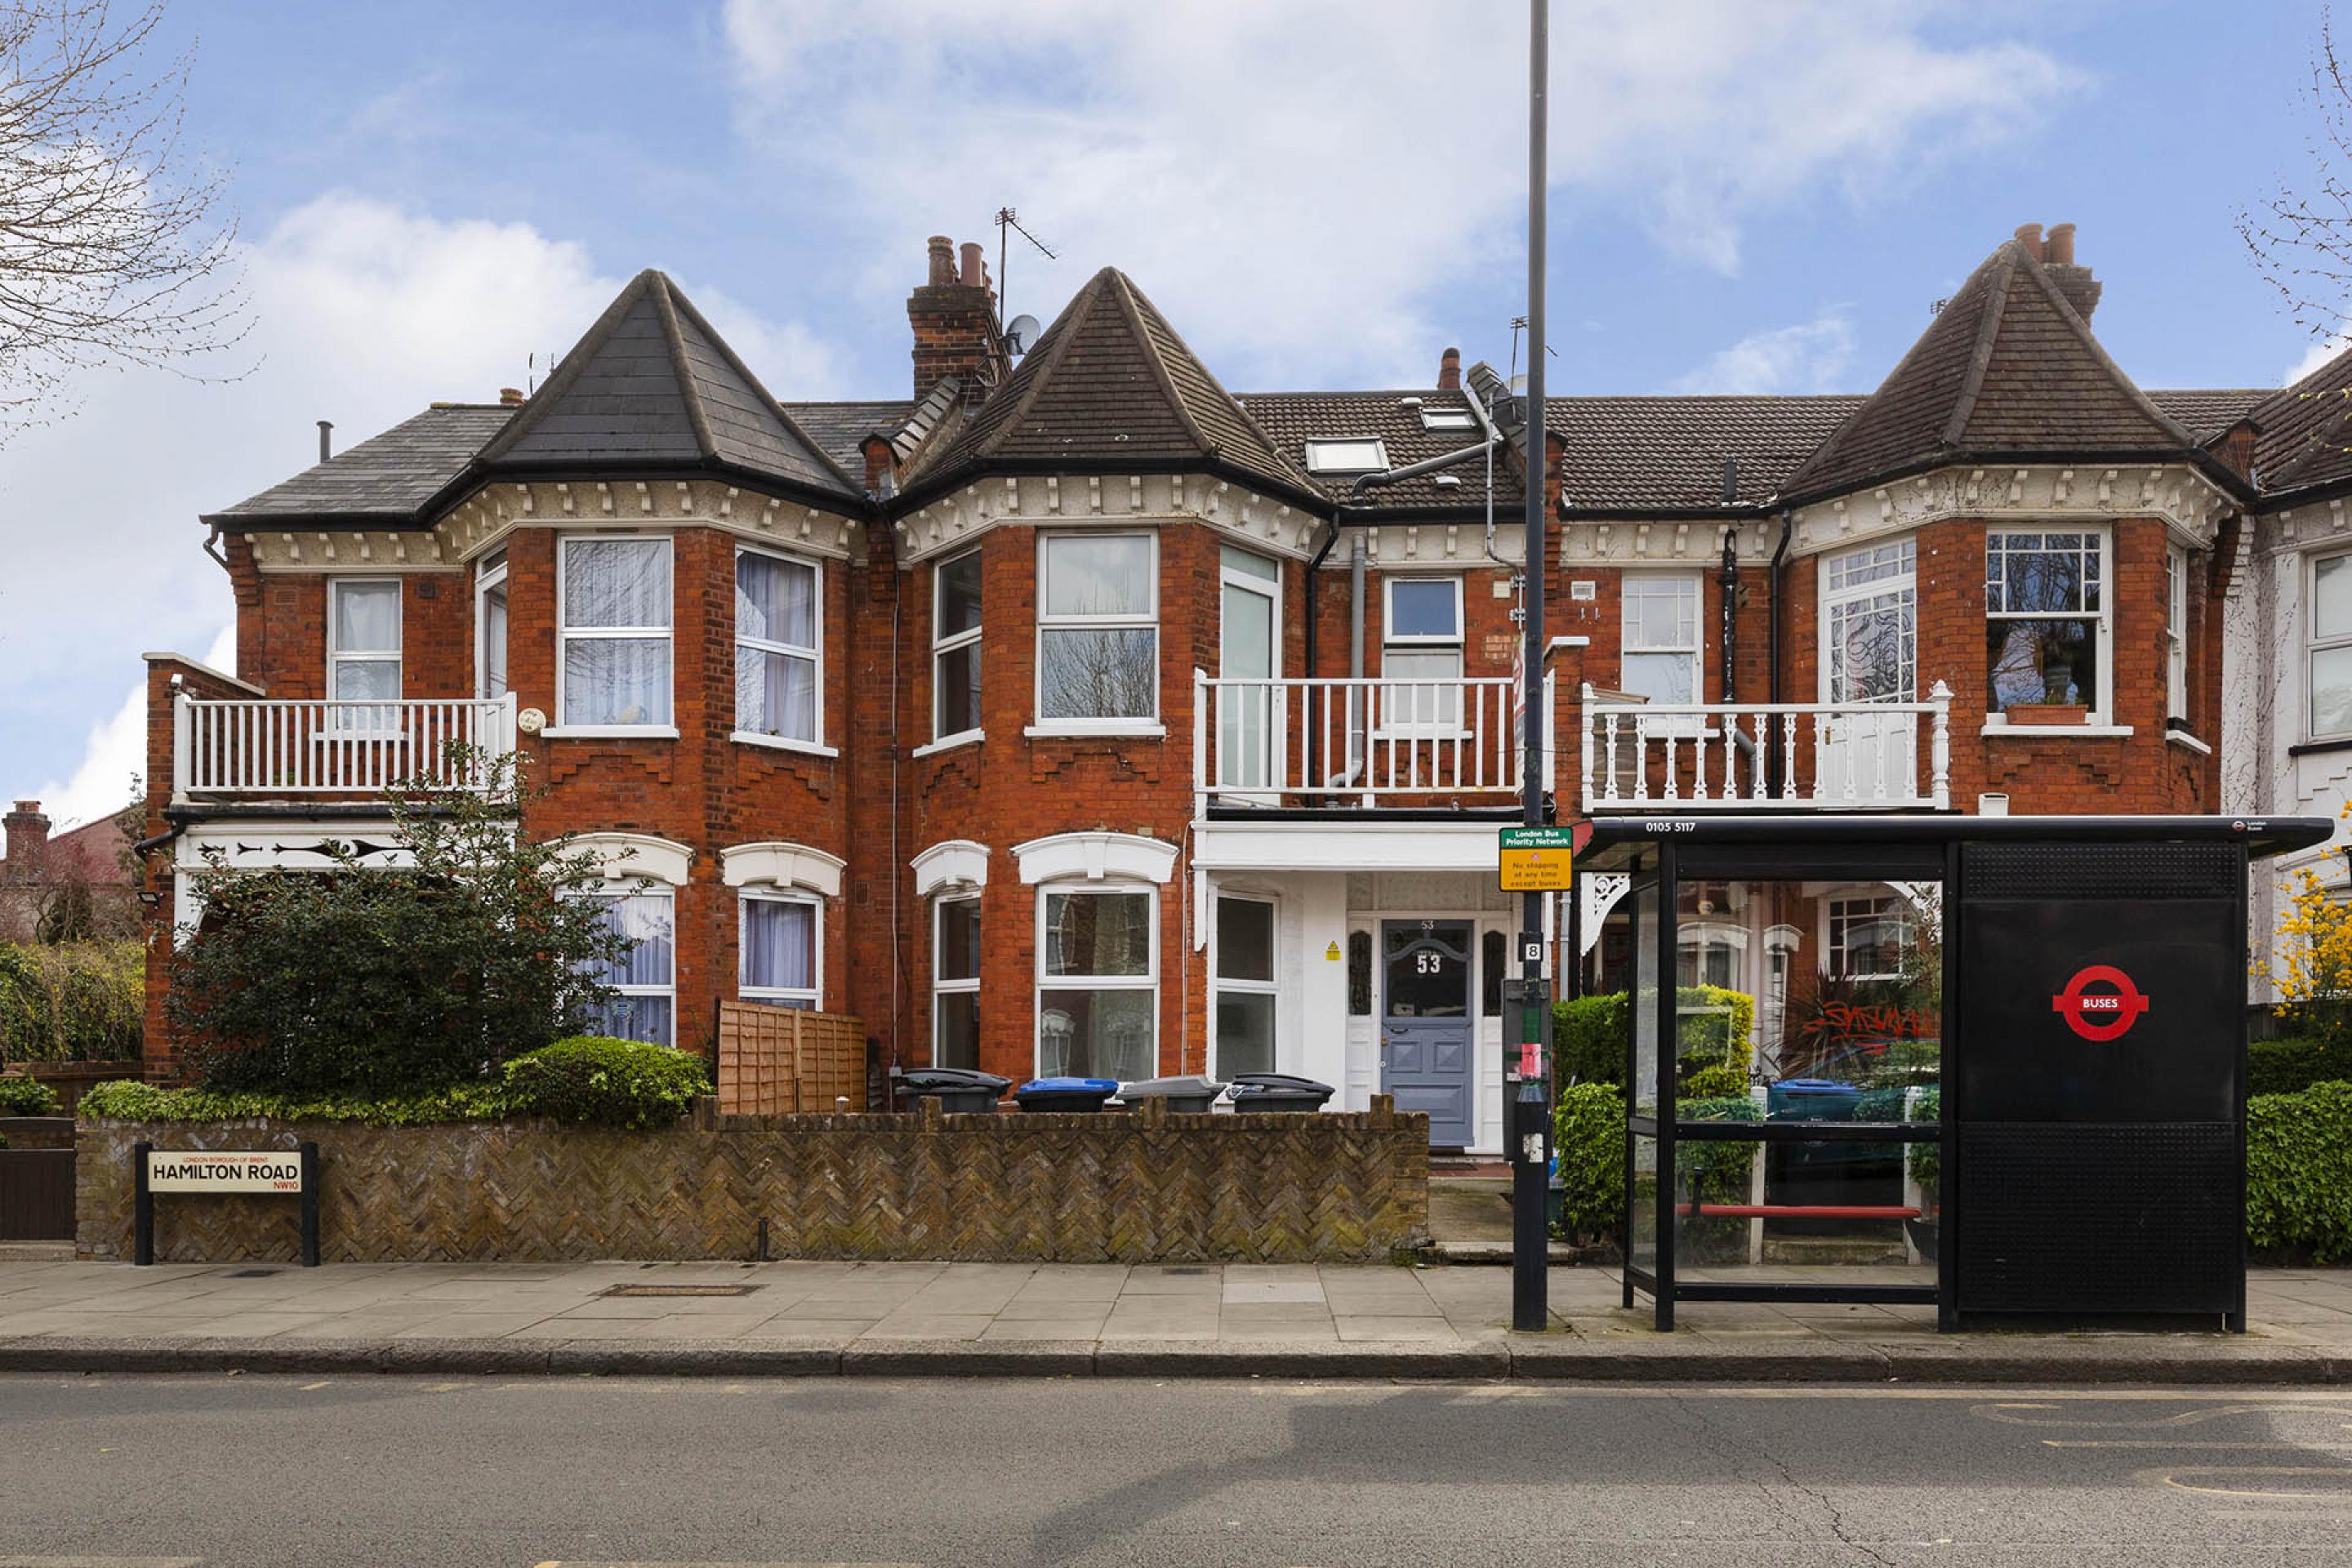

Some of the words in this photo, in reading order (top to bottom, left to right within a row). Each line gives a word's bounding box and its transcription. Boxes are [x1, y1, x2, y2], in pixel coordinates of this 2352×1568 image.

[1646, 822, 1671, 832] 0105
[1674, 822, 1696, 832] 5117
[1506, 838, 1534, 846] Priority
[1535, 837, 1568, 845] Network
[1421, 920, 1434, 929] 53
[1529, 945, 1538, 958] 8
[1417, 955, 1441, 973] 53
[2082, 999, 2118, 1009] BUSES
[154, 1165, 242, 1179] HAMILTON
[247, 1165, 298, 1179] ROAD
[274, 1181, 298, 1190] NW10
